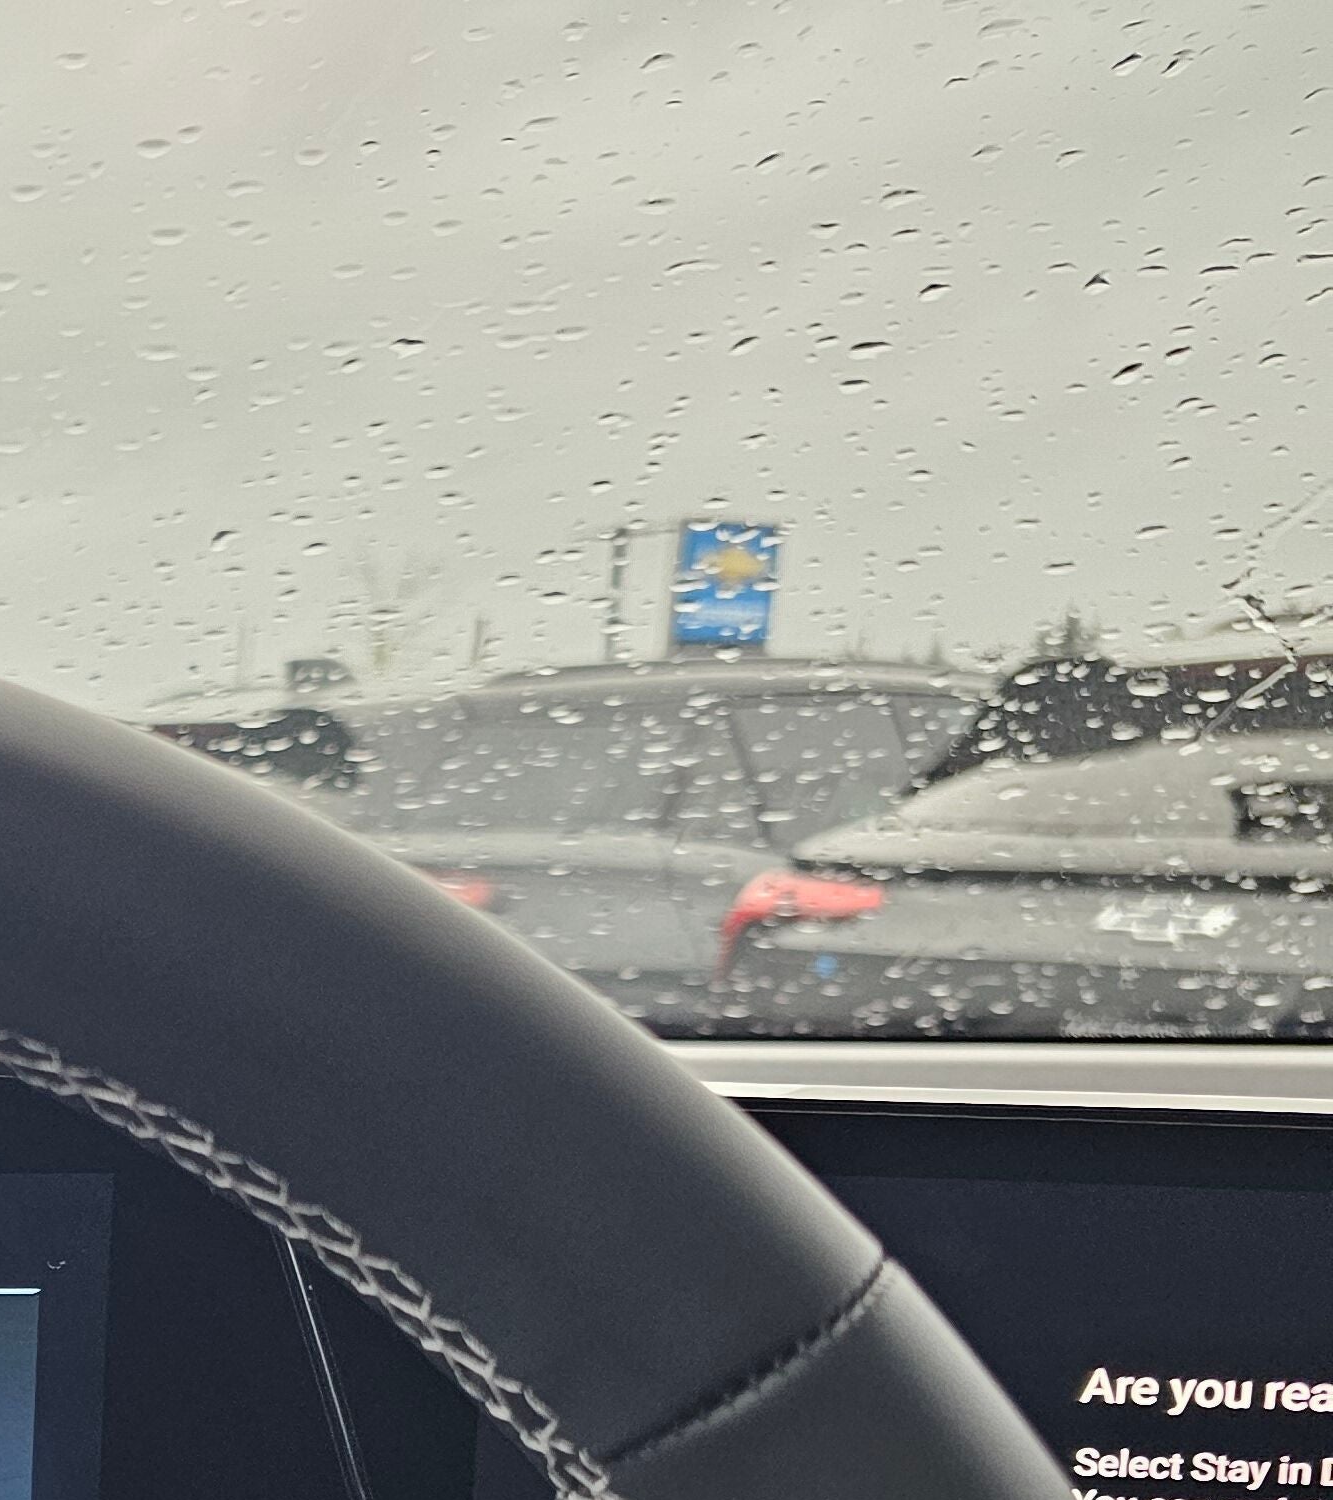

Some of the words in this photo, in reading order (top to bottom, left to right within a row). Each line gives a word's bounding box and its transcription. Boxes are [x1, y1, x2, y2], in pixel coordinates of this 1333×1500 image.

[1078, 1367, 1160, 1406] Are
[1166, 1378, 1254, 1416] you
[1263, 1381, 1333, 1413] rea
[1073, 1447, 1185, 1481] Select
[1189, 1451, 1272, 1491] Stay
[1277, 1455, 1313, 1486] in
